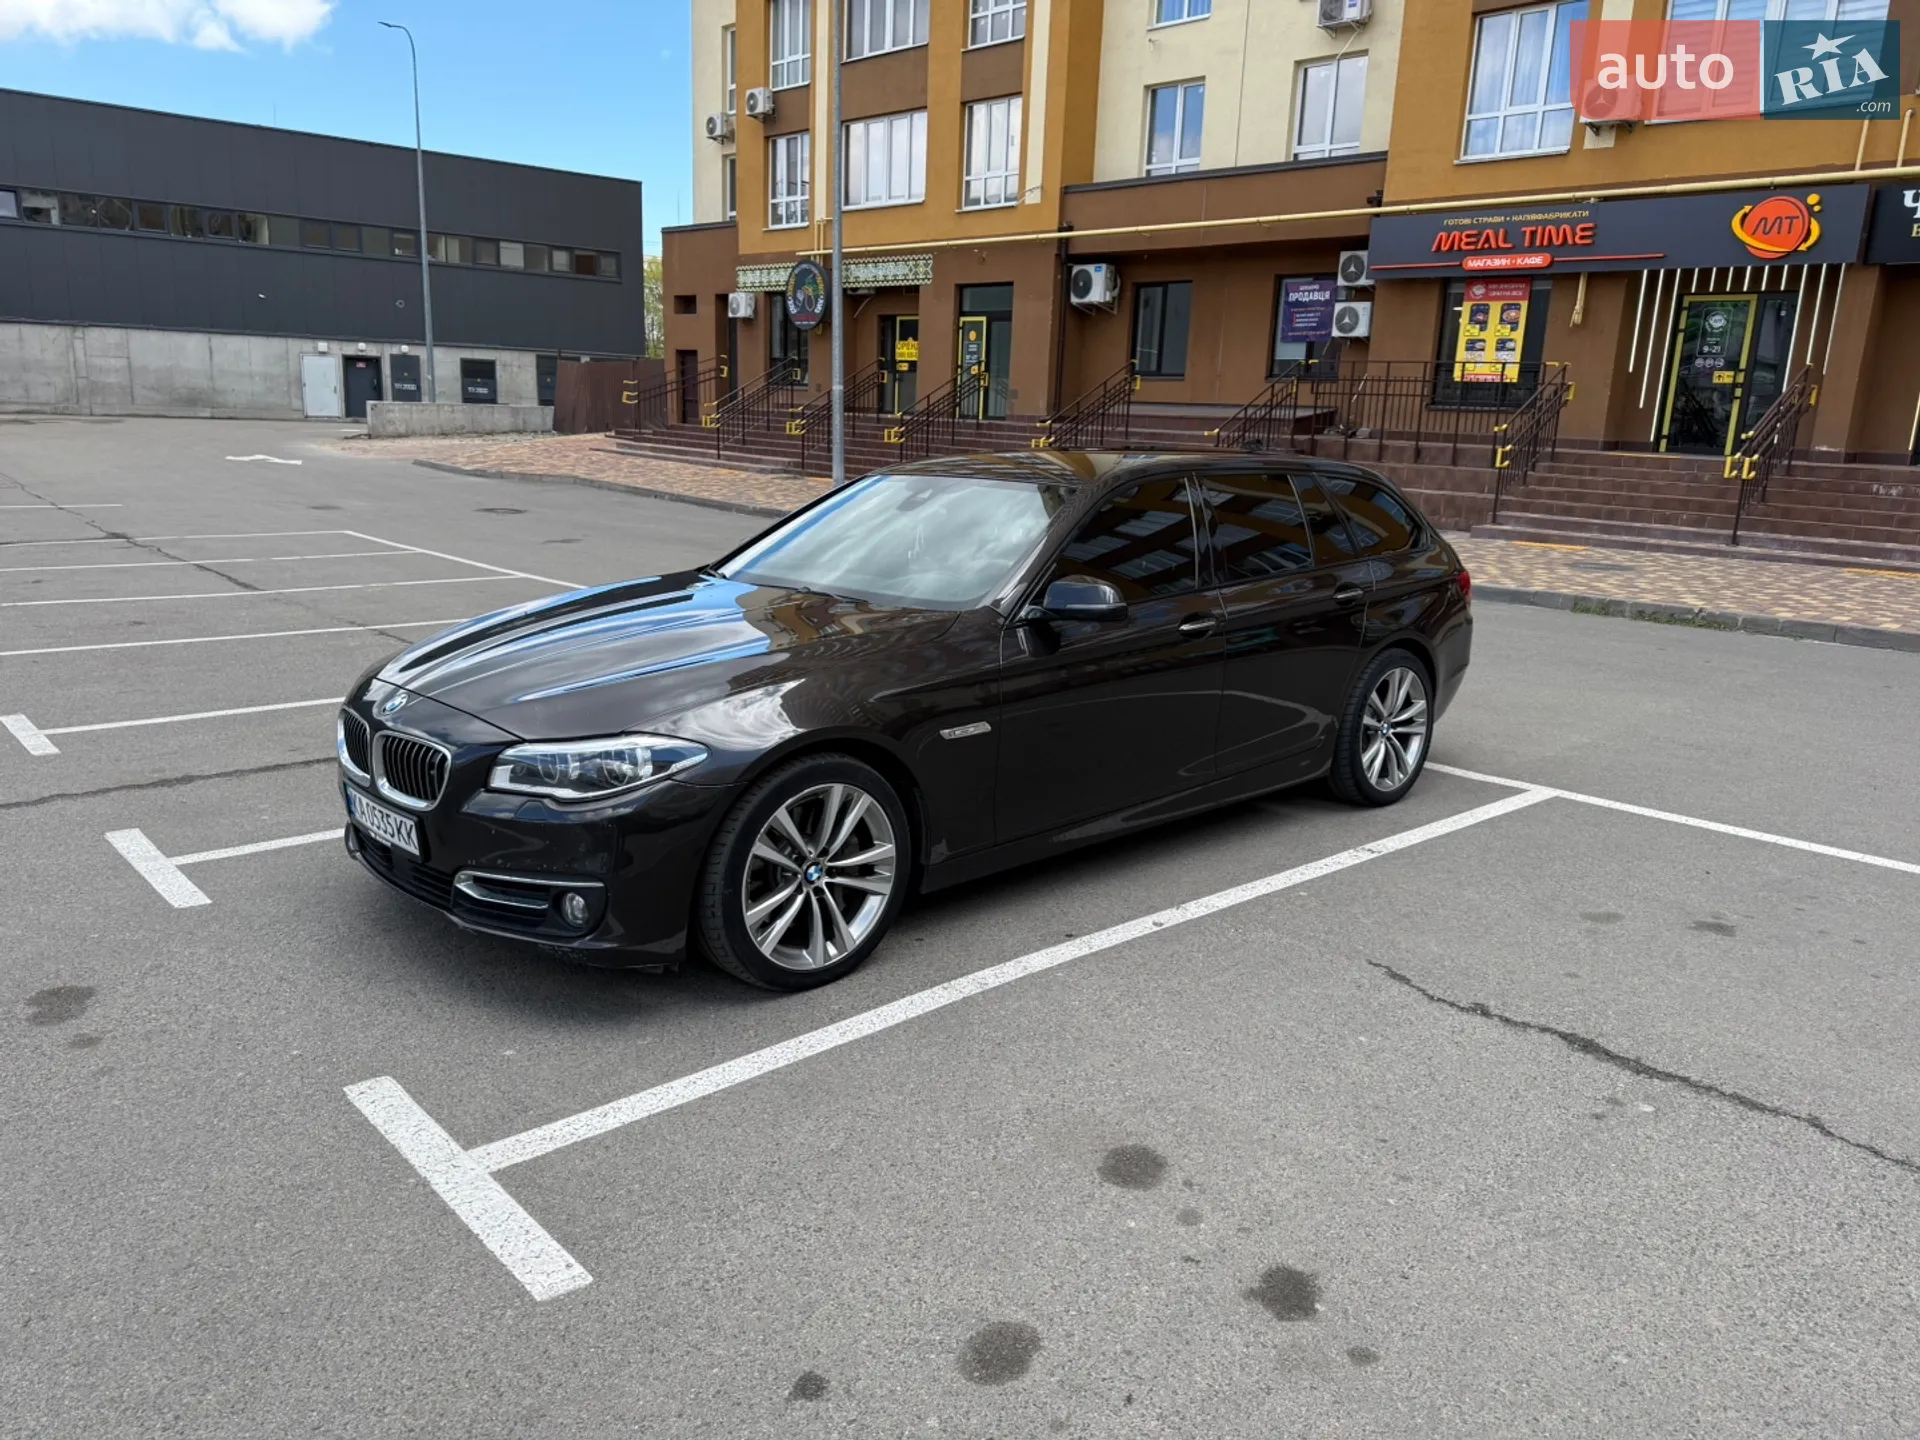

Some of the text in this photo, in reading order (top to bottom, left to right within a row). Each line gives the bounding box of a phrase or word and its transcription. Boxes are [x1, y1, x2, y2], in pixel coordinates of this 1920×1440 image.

[1443, 210, 1590, 226] ГОТОВІ СТРАВИ НАПІВФАБРИКАТИ
[1431, 223, 1596, 252] MEAL TIME
[1467, 256, 1544, 268] МАГАЗИН КАФЕ
[1288, 290, 1331, 302] ПРОДАВЦЯ
